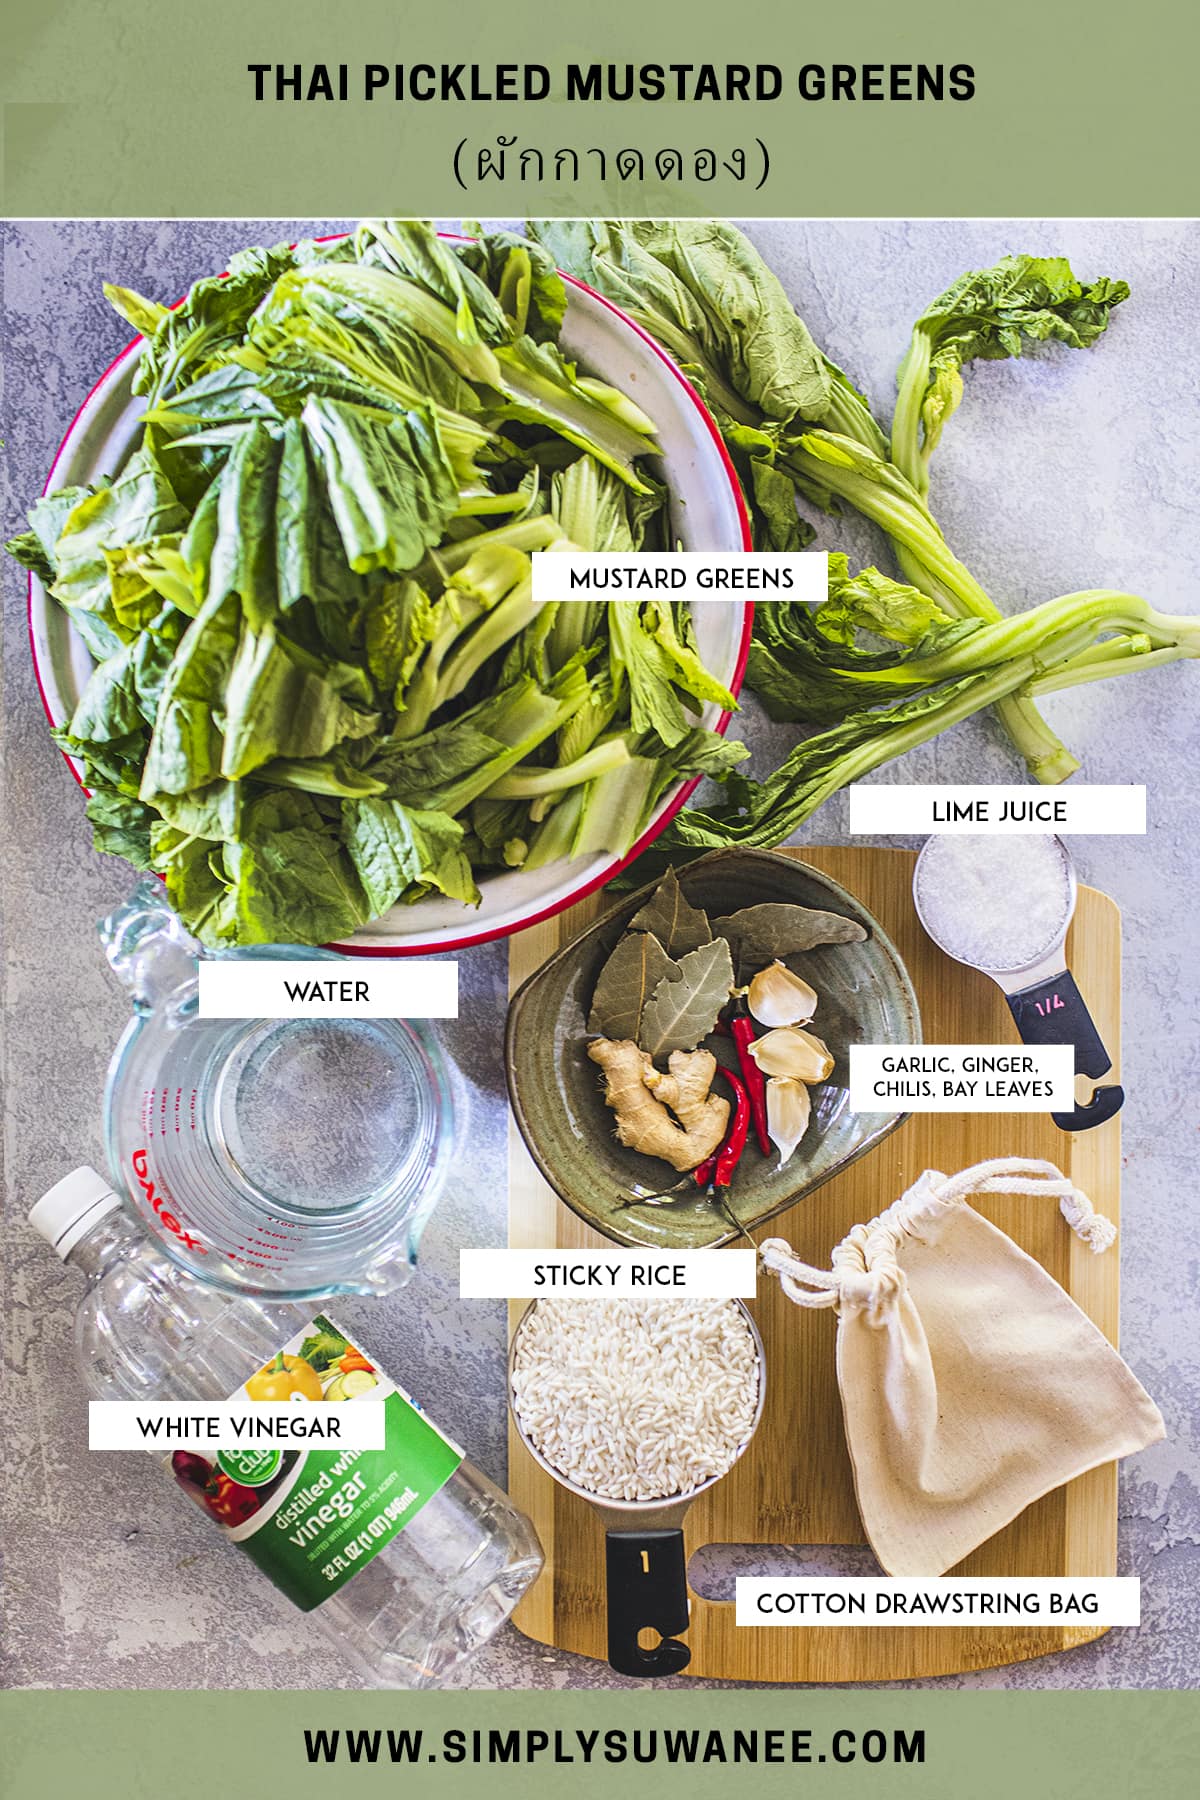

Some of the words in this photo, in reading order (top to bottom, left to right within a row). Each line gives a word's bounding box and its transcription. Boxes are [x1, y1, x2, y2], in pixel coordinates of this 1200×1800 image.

[1035, 994, 1065, 1016] 1/4
[276, 1471, 333, 1529] distilled
[329, 1450, 366, 1476] whi
[289, 1471, 366, 1547] vinegar
[321, 1564, 340, 1581] 32
[331, 1555, 351, 1572] FL
[343, 1540, 364, 1561] OZ
[356, 1530, 374, 1551] (1
[383, 1486, 419, 1522] 946mL
[640, 1551, 649, 1573] 1
